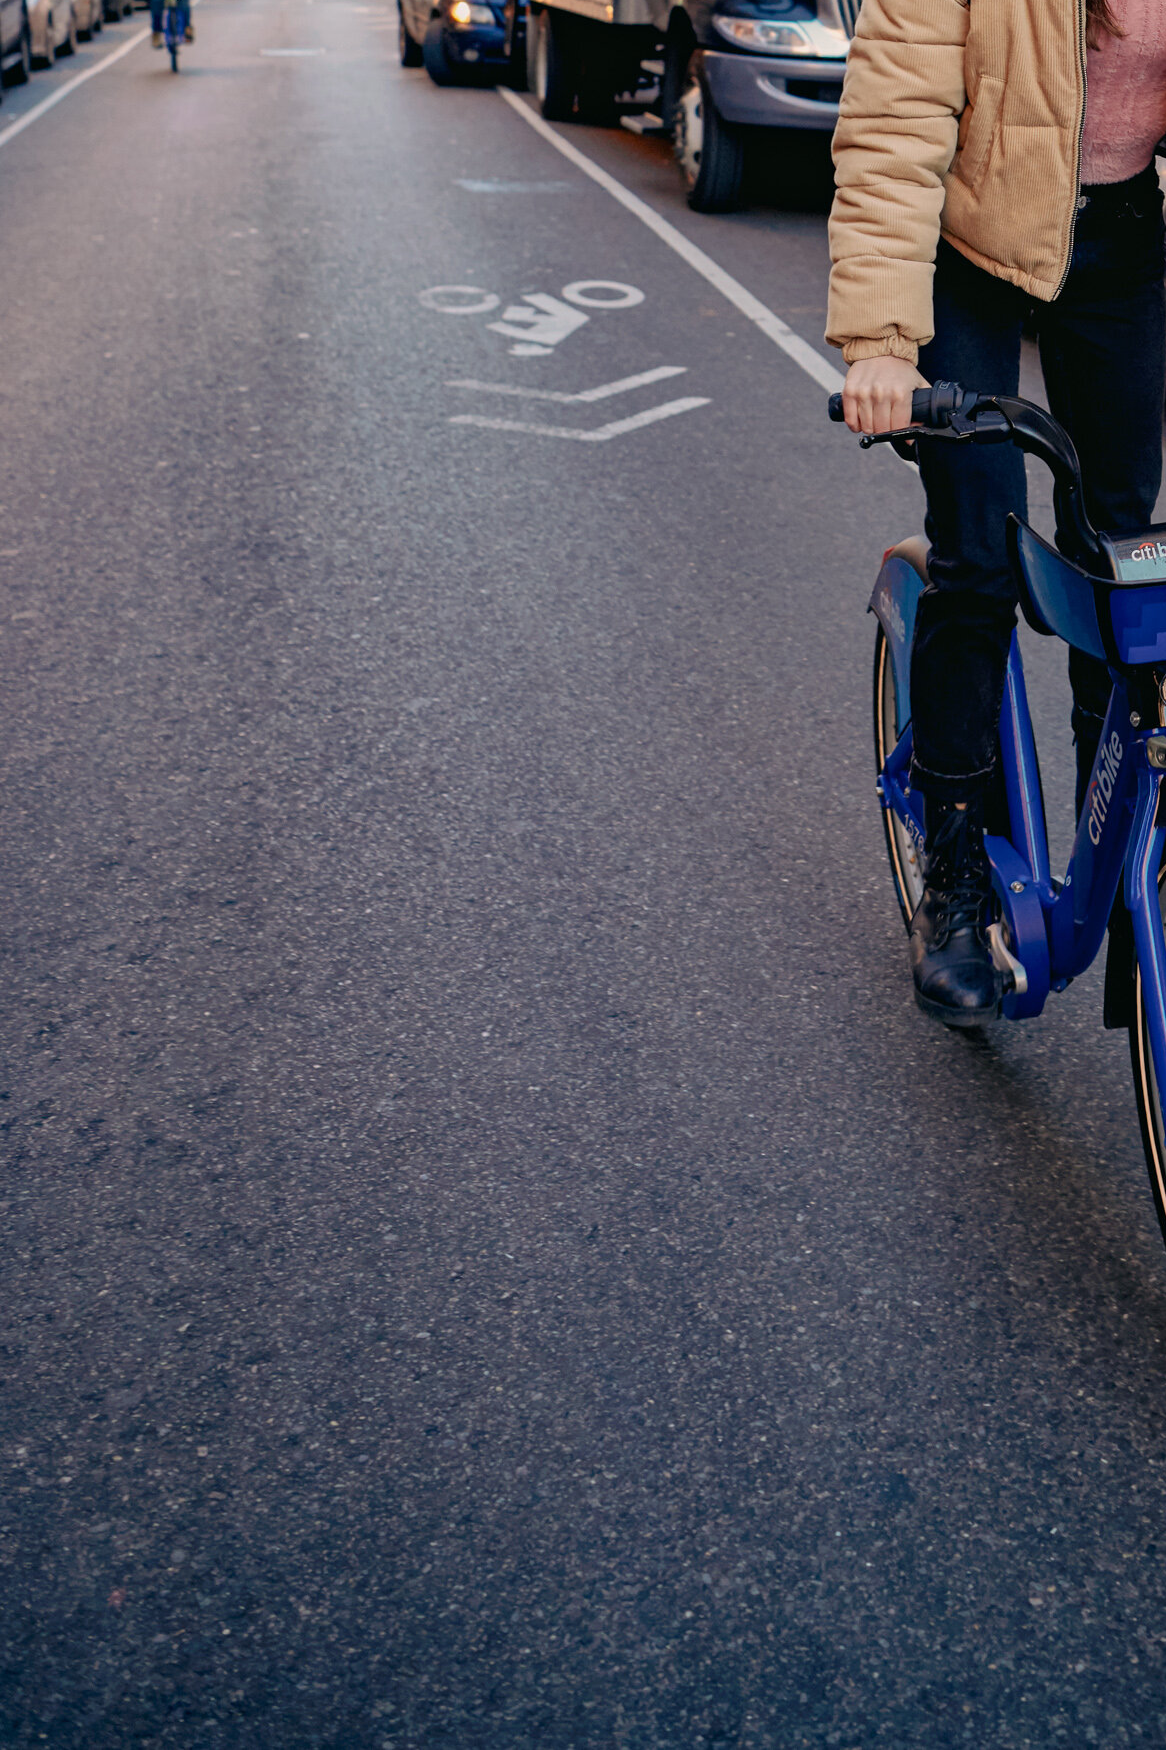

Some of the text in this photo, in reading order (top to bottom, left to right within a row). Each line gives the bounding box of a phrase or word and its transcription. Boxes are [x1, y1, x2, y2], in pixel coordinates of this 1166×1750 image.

[1131, 542, 1156, 562] citi
[1088, 730, 1123, 846] citi bike
